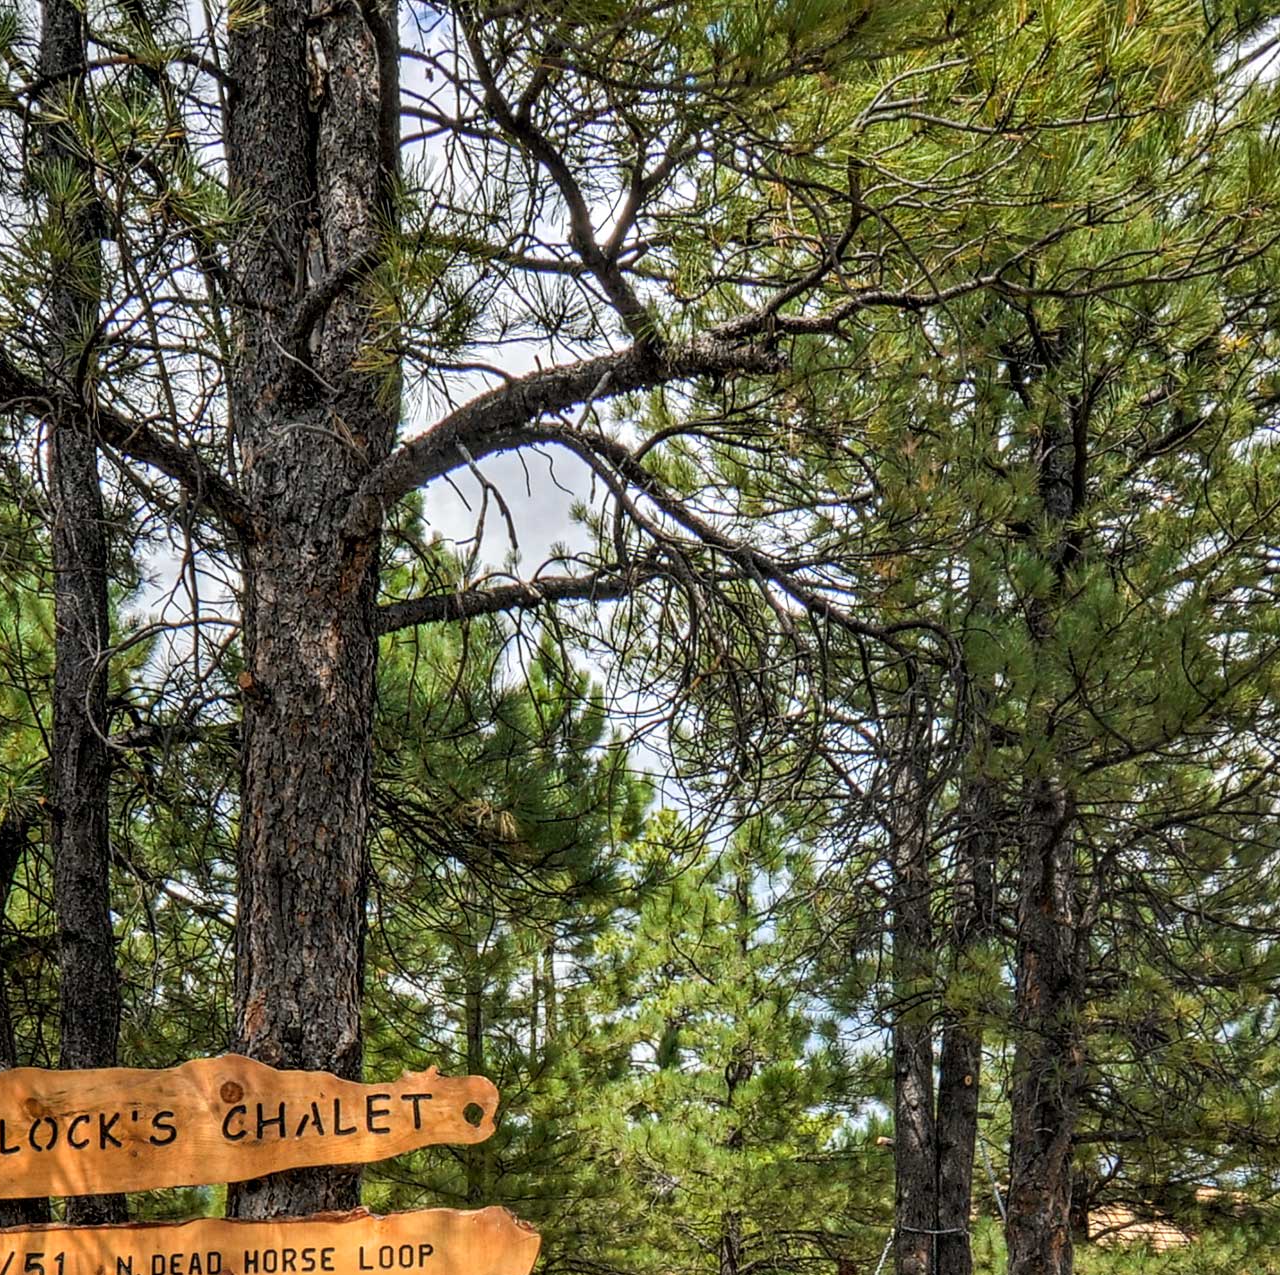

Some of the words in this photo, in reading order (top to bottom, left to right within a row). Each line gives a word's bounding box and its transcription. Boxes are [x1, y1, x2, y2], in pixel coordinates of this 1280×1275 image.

[221, 1093, 433, 1141] CHALET
[244, 1247, 336, 1274] HORSE
[358, 1244, 435, 1270] LOOP
